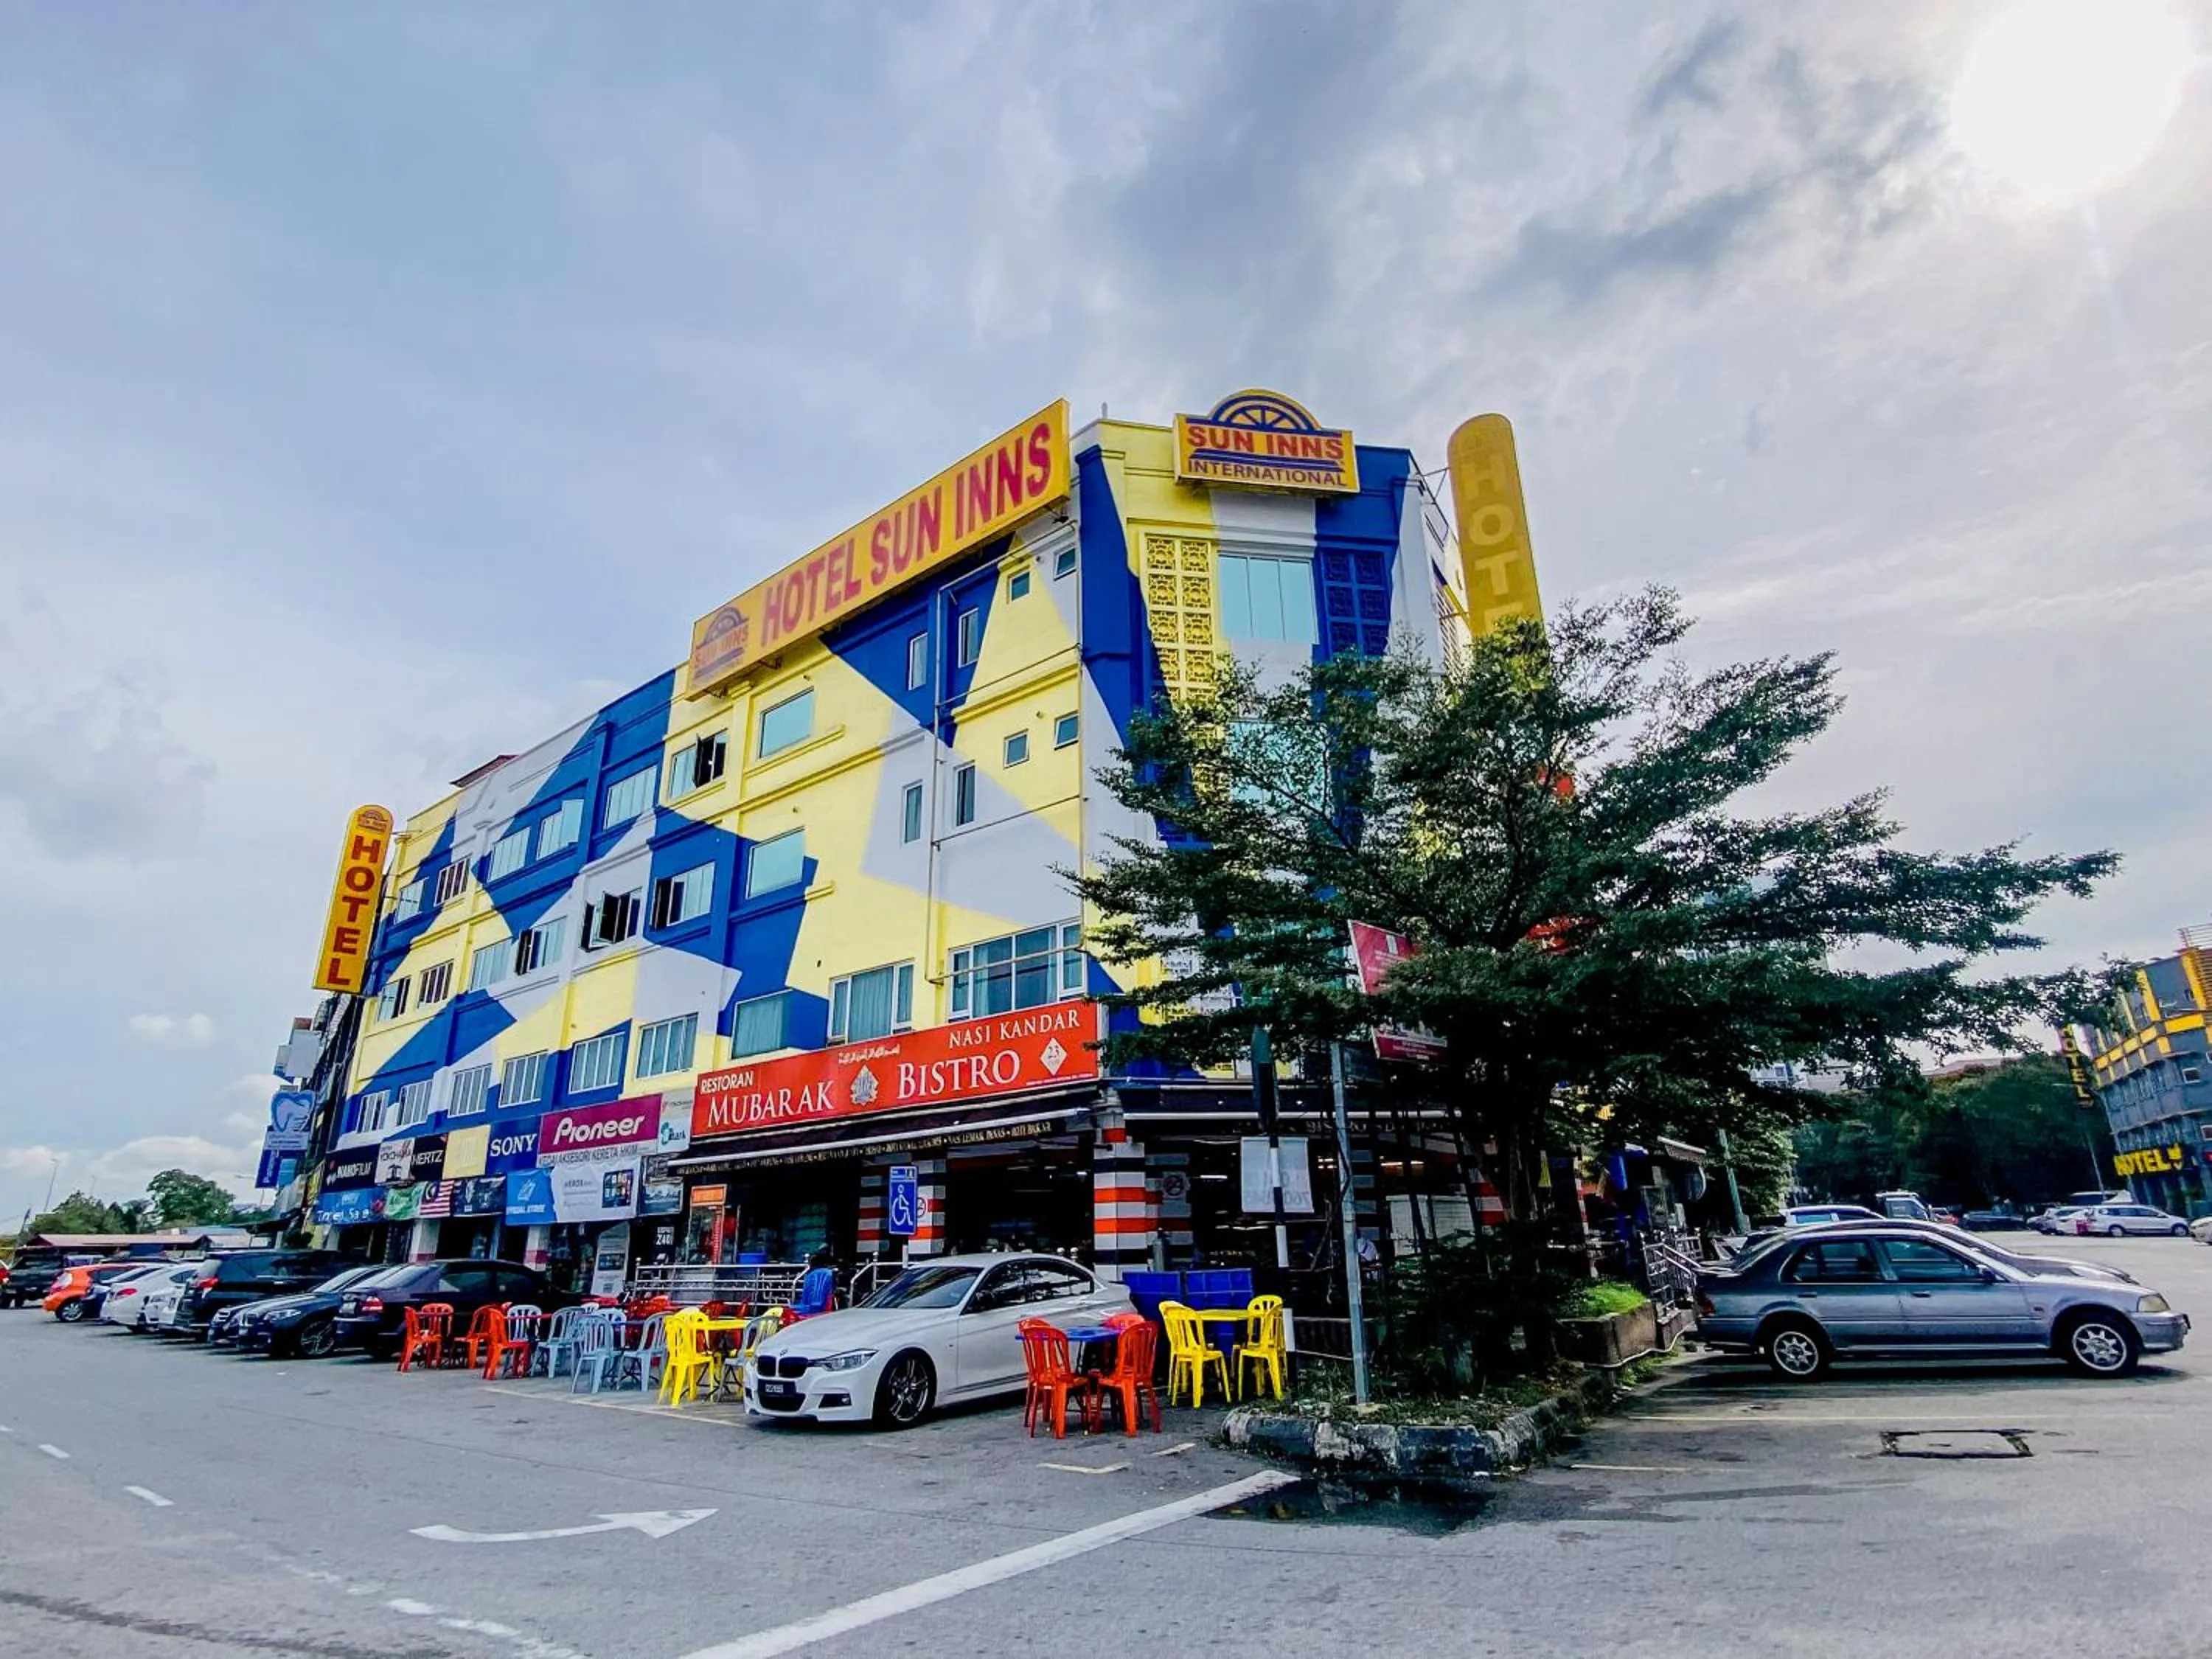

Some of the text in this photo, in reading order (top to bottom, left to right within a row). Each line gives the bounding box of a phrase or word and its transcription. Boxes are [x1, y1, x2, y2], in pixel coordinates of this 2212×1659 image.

[1187, 425, 1344, 459] SUN INNS
[1188, 460, 1346, 487] INTERNATIONAL
[760, 422, 1051, 648] HOTEL SUN INNS
[1459, 453, 1524, 636] HOT
[327, 835, 381, 986] HOTEL
[949, 1009, 1080, 1049] NASI KANDAR
[700, 1071, 754, 1094] RESTORAN
[897, 1049, 1021, 1099] BISTRO
[708, 1079, 835, 1128] MUBARAK
[490, 1133, 538, 1157] SONY
[553, 1115, 645, 1145] Pioneer
[411, 1150, 444, 1166] HERTZ
